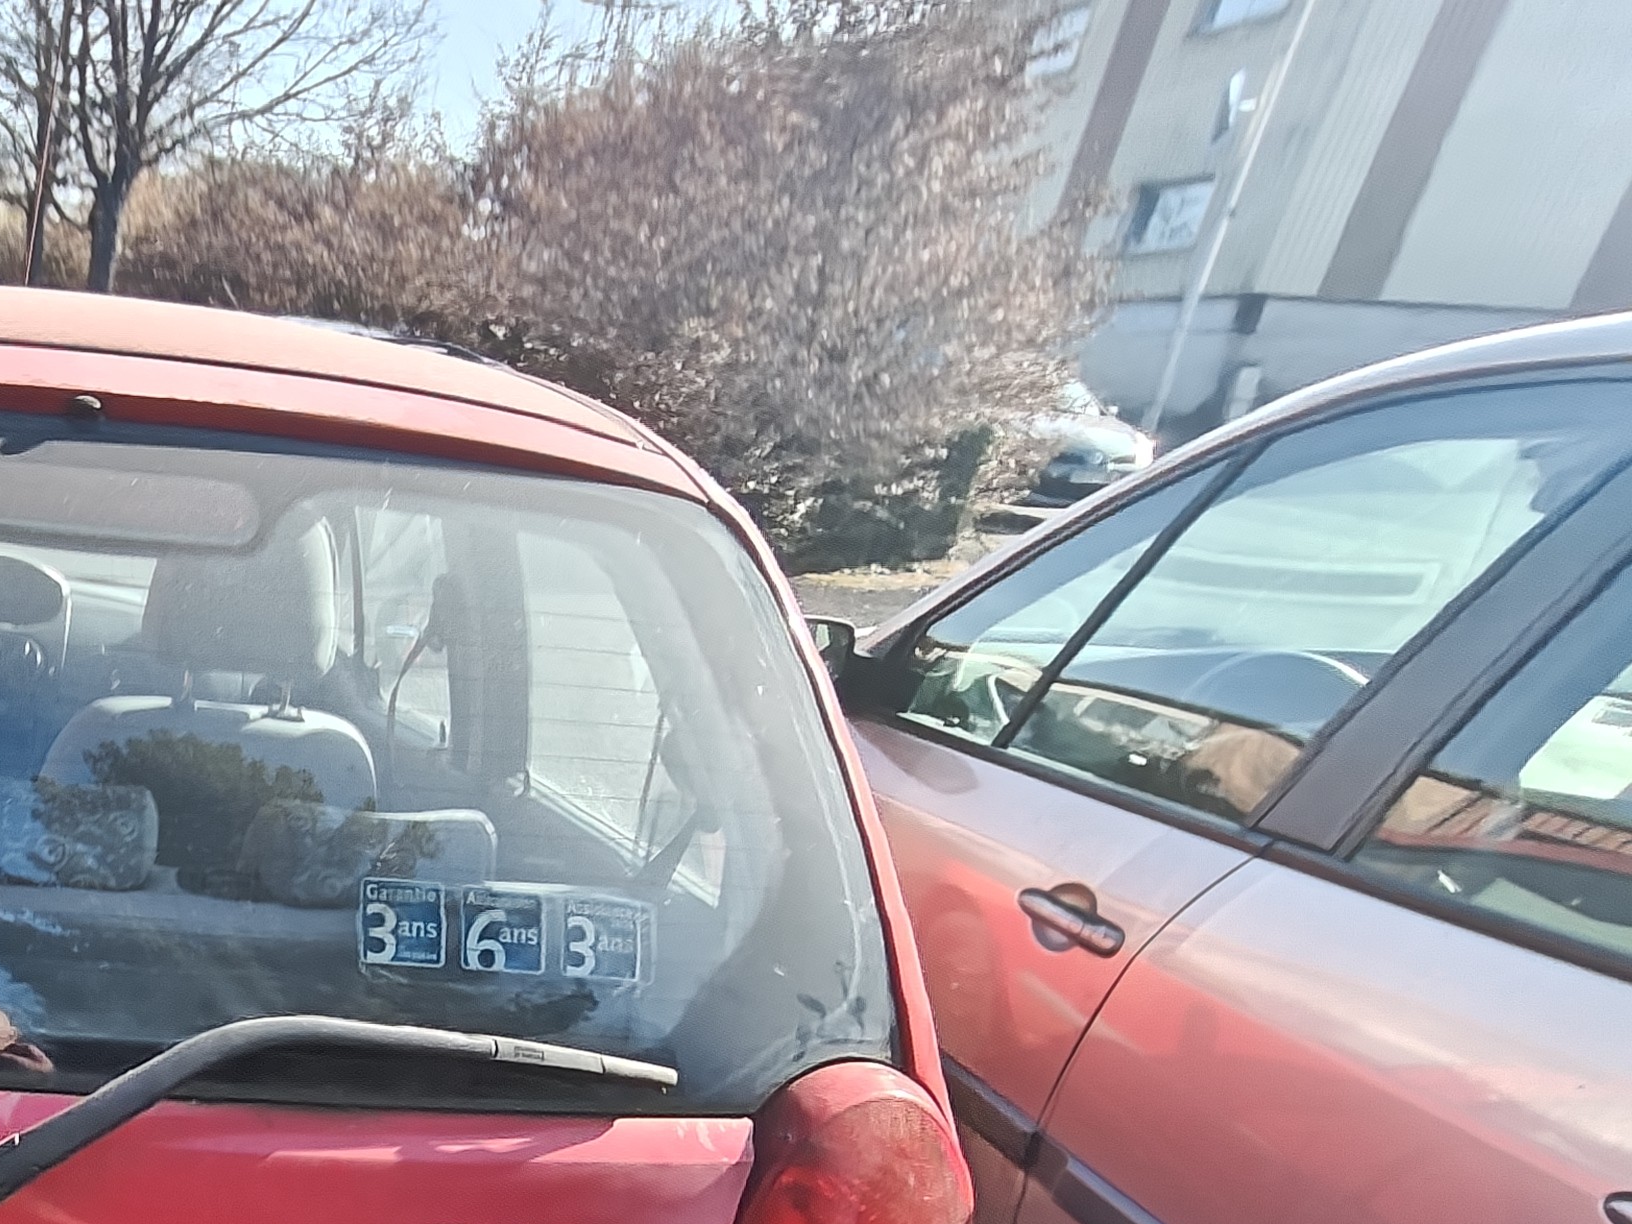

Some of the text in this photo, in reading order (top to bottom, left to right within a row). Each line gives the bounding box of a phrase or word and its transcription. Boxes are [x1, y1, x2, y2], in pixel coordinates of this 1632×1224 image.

[366, 903, 438, 963] 3 ans
[466, 909, 539, 971] 6 ans
[566, 915, 596, 977] 3
